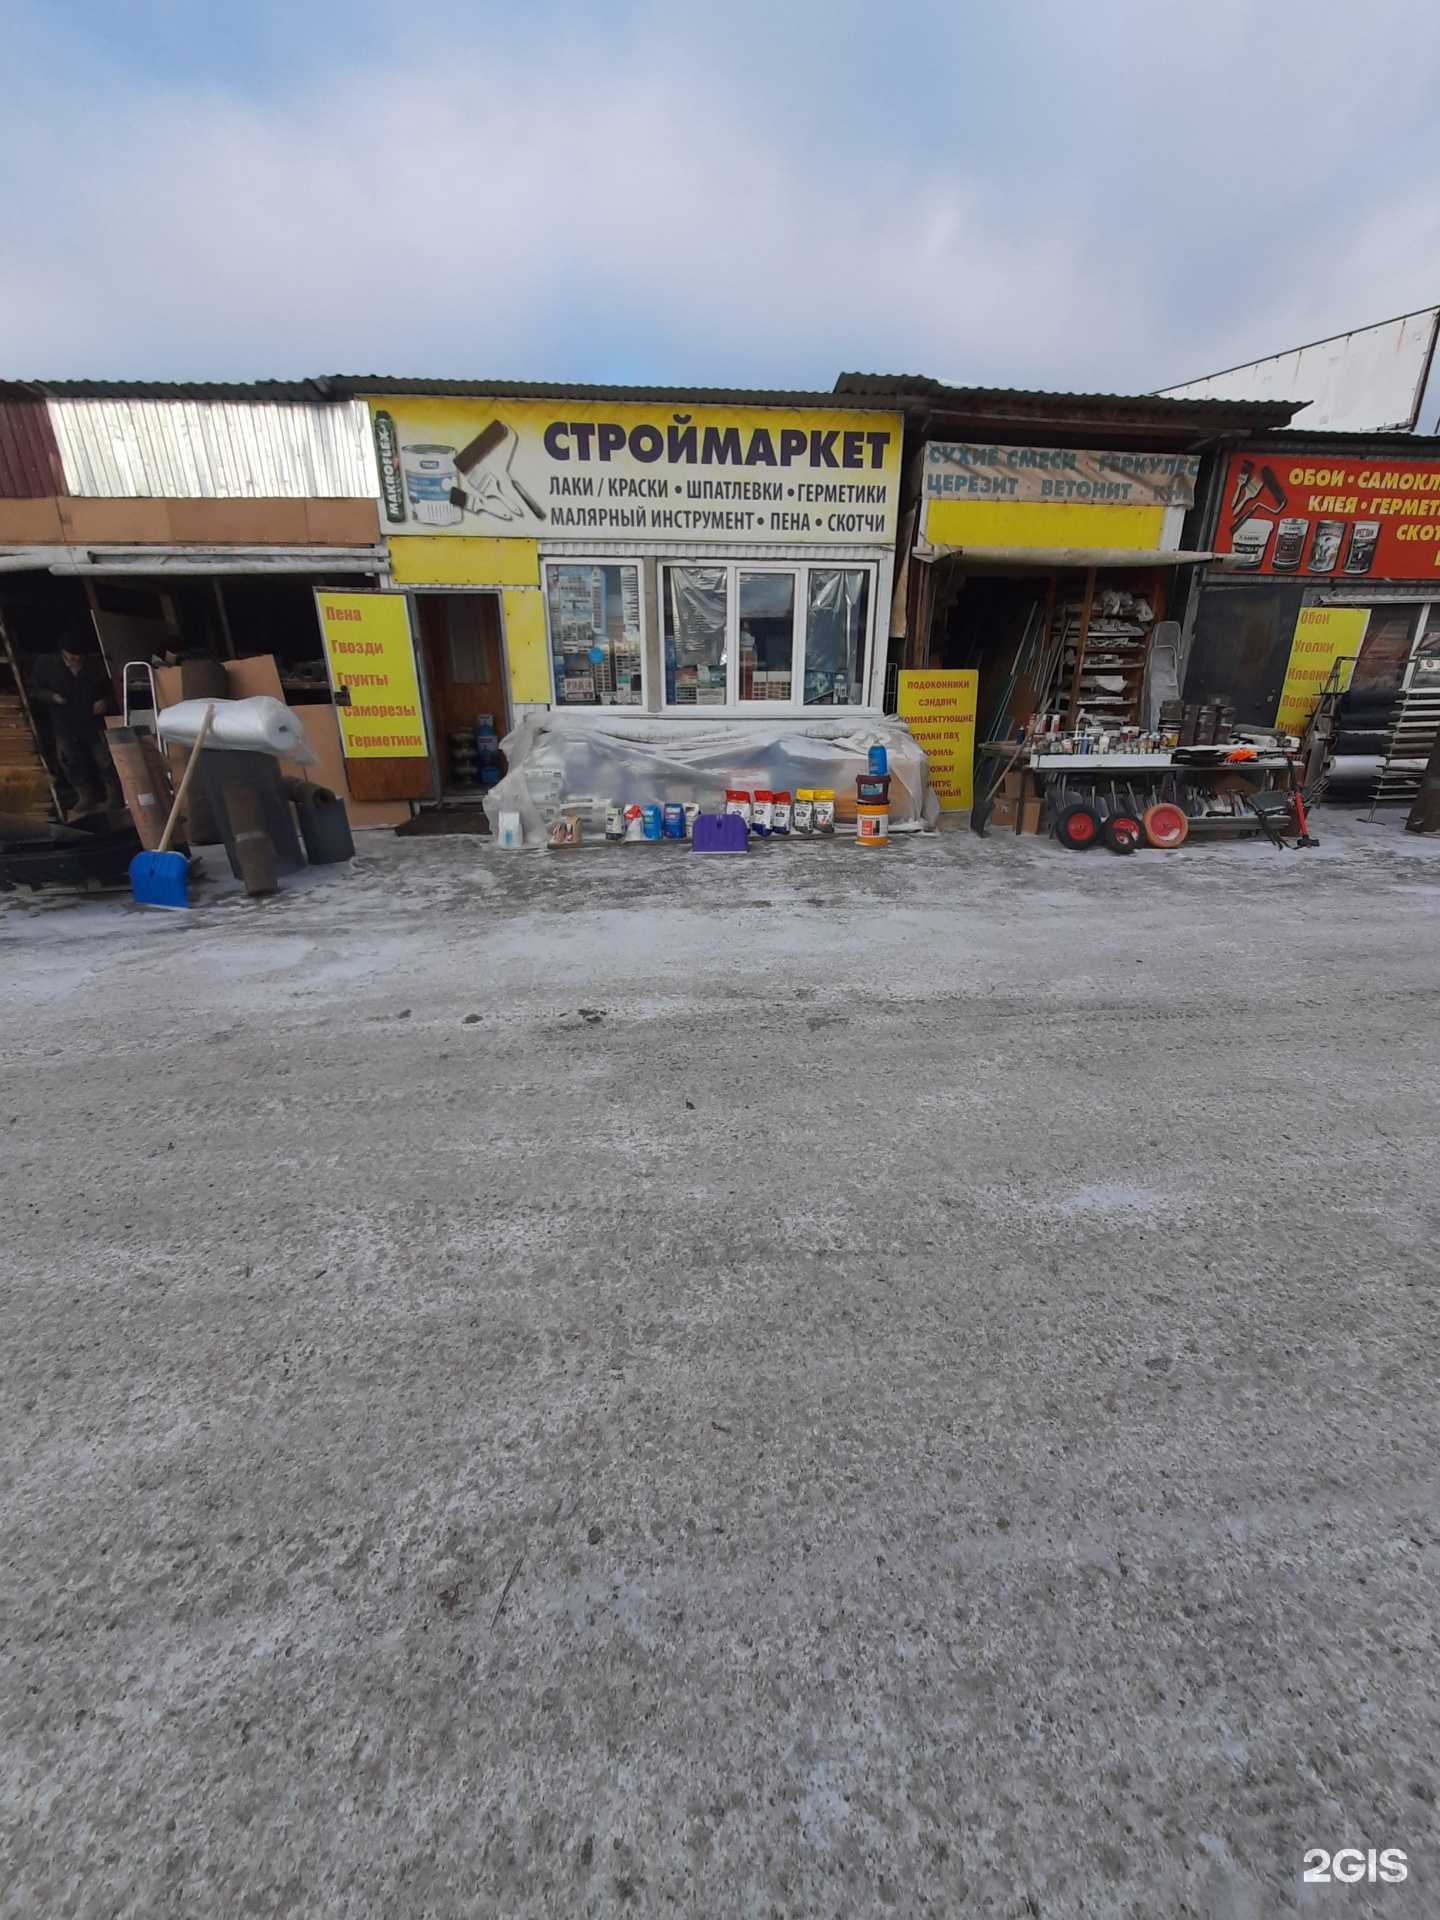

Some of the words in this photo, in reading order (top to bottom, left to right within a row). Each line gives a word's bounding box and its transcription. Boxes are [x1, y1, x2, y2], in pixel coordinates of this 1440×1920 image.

[544, 414, 890, 469] СТРОЙМАРКЕТ
[928, 446, 999, 467] СУХИЕ
[379, 430, 400, 514] MAKROFLEX
[1289, 467, 1345, 487] ОБОИ
[550, 476, 593, 496] ЛАКИ
[608, 478, 668, 498] КРАСКИ
[687, 480, 782, 500] ШПАТЛЕВКИ
[798, 484, 886, 504] ГЕРМЕТИКИ
[927, 473, 1018, 495] ЦЕРЕЗИТ
[1041, 479, 1132, 499] ВЕТОНИТ
[1308, 495, 1358, 513] КЛЕЯ
[1369, 498, 1440, 516] ГЕРМЕТ
[551, 506, 646, 527] МАЛЯРНЫЙ
[652, 510, 755, 530] ИНСТРУМЕНТ
[771, 512, 810, 531] ПЕНА
[828, 514, 884, 532] СКОТЧИ
[326, 606, 362, 621] Пена
[331, 639, 384, 656] Гвозди
[337, 672, 389, 687] Грунты
[907, 680, 970, 690] ПОДОКОННИКИ
[343, 704, 416, 718] Саморезы
[904, 713, 974, 724] ОМПЛЕКТУЮЩИЕ
[348, 734, 422, 749] Герметики
[924, 749, 954, 757] ОФИЛЬ
